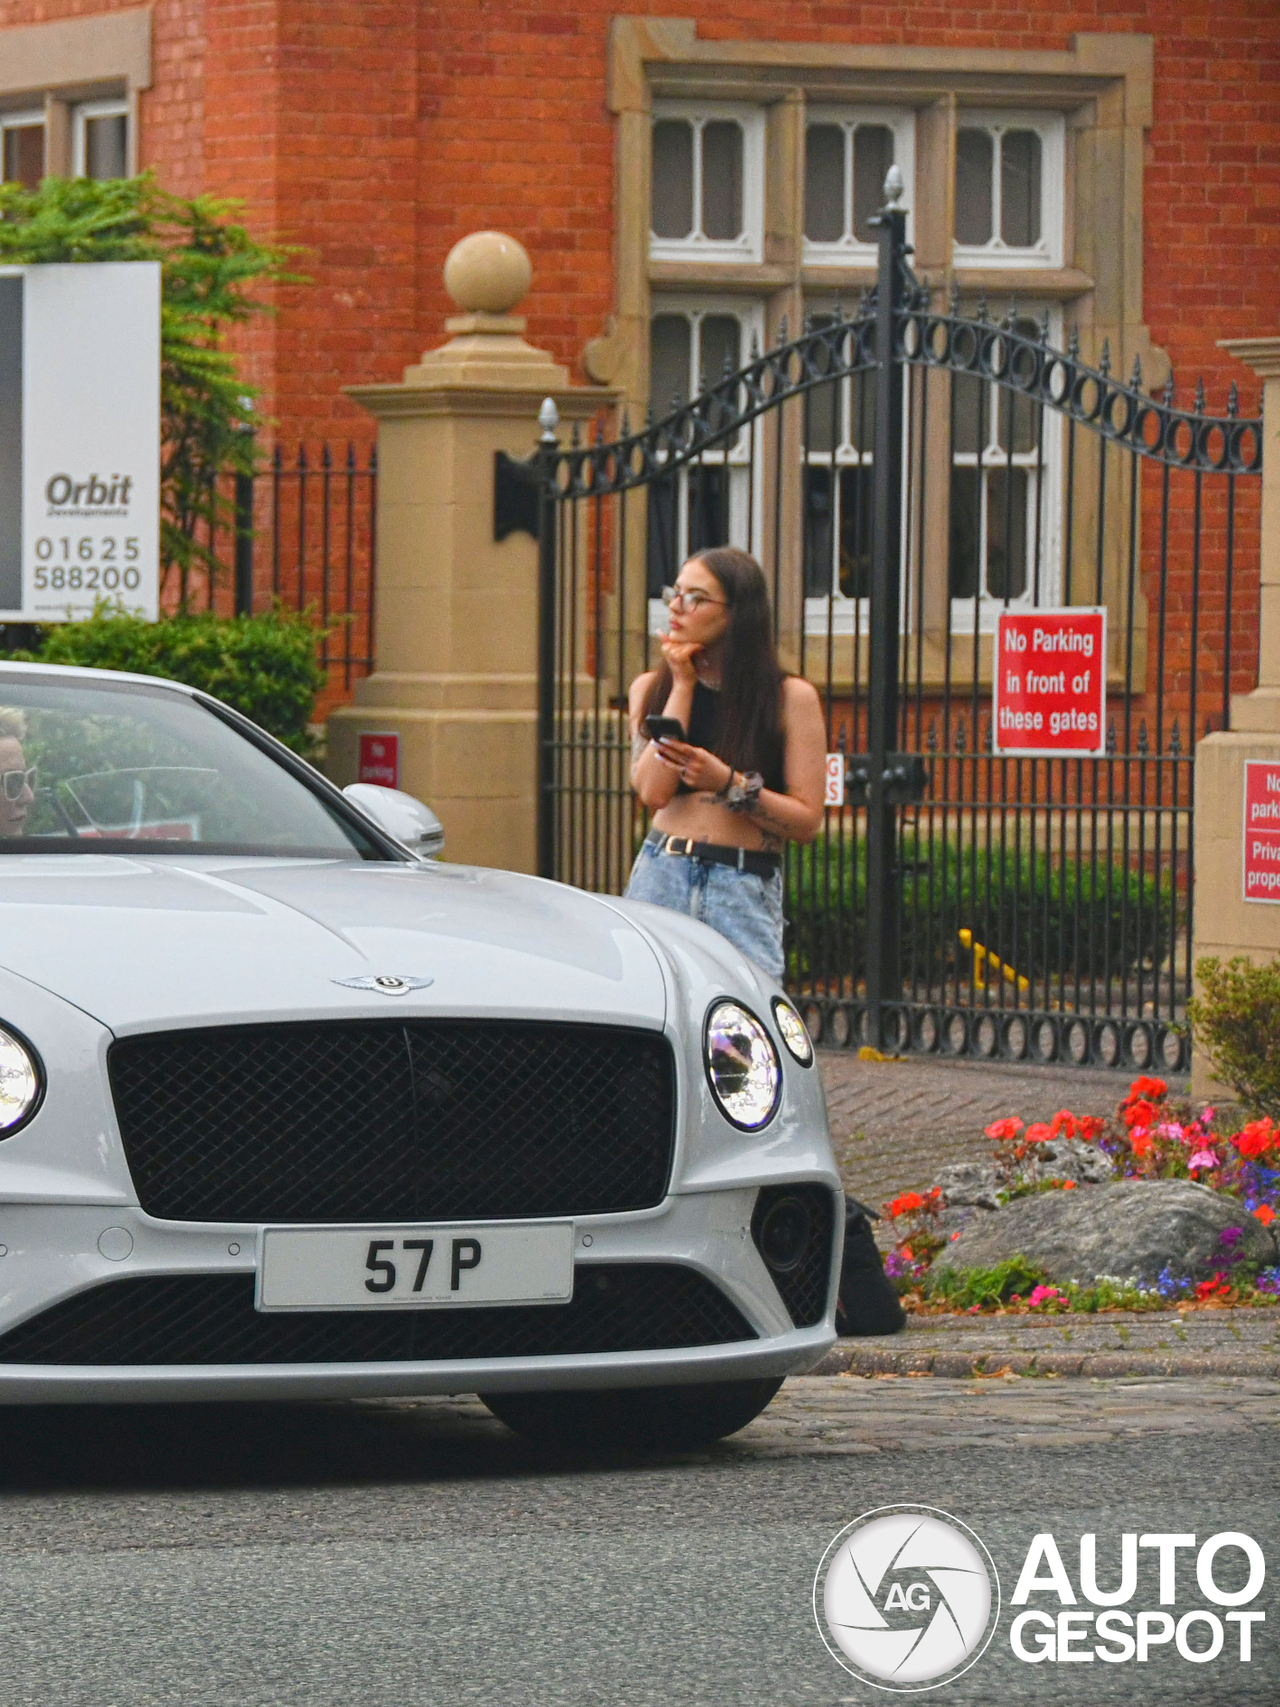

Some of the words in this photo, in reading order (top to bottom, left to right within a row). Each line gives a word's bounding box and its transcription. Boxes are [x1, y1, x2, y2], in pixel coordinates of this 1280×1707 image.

[46, 472, 133, 506] Orbit
[35, 536, 139, 561] 01625
[34, 566, 140, 591] 588200
[1005, 628, 1027, 651] No
[1033, 628, 1094, 657] Parking
[1006, 670, 1020, 693] in
[1026, 670, 1065, 693] front
[1072, 670, 1091, 693] of
[1000, 706, 1043, 729] these
[1050, 708, 1098, 735] gates
[364, 1239, 434, 1293] 57
[450, 1238, 482, 1291] P
